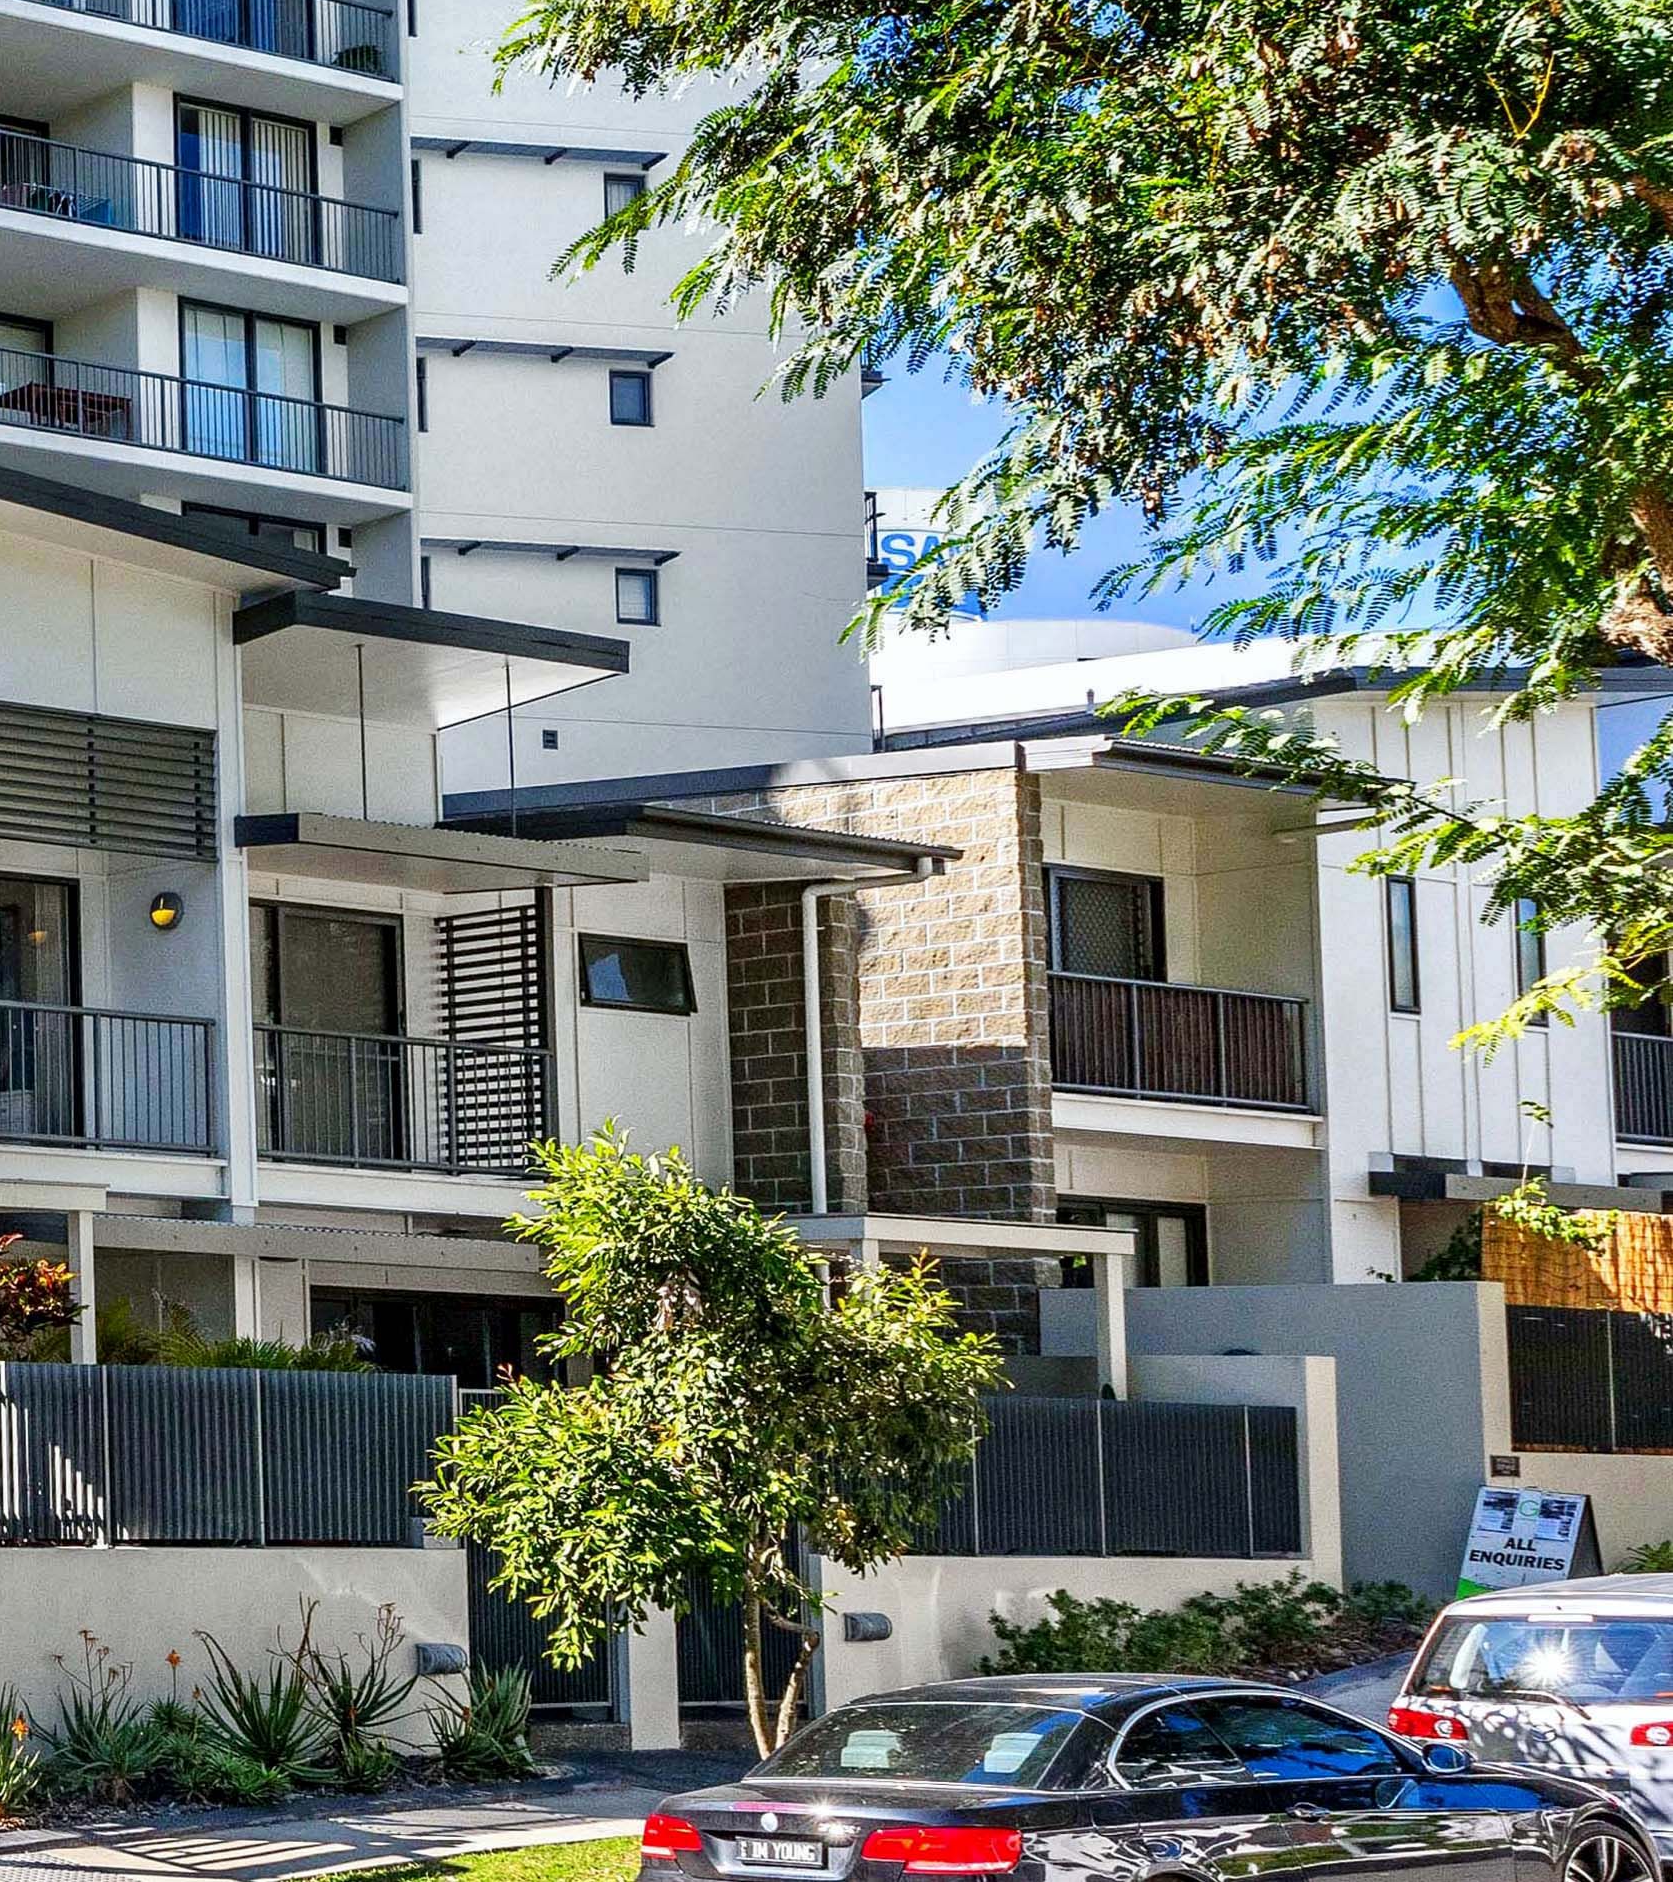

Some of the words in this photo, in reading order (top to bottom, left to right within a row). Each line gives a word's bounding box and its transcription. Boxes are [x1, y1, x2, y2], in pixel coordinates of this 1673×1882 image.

[1503, 1537, 1537, 1552] ALL
[1468, 1549, 1566, 1571] ENQUIRIES
[773, 1841, 816, 1862] YOUNG
